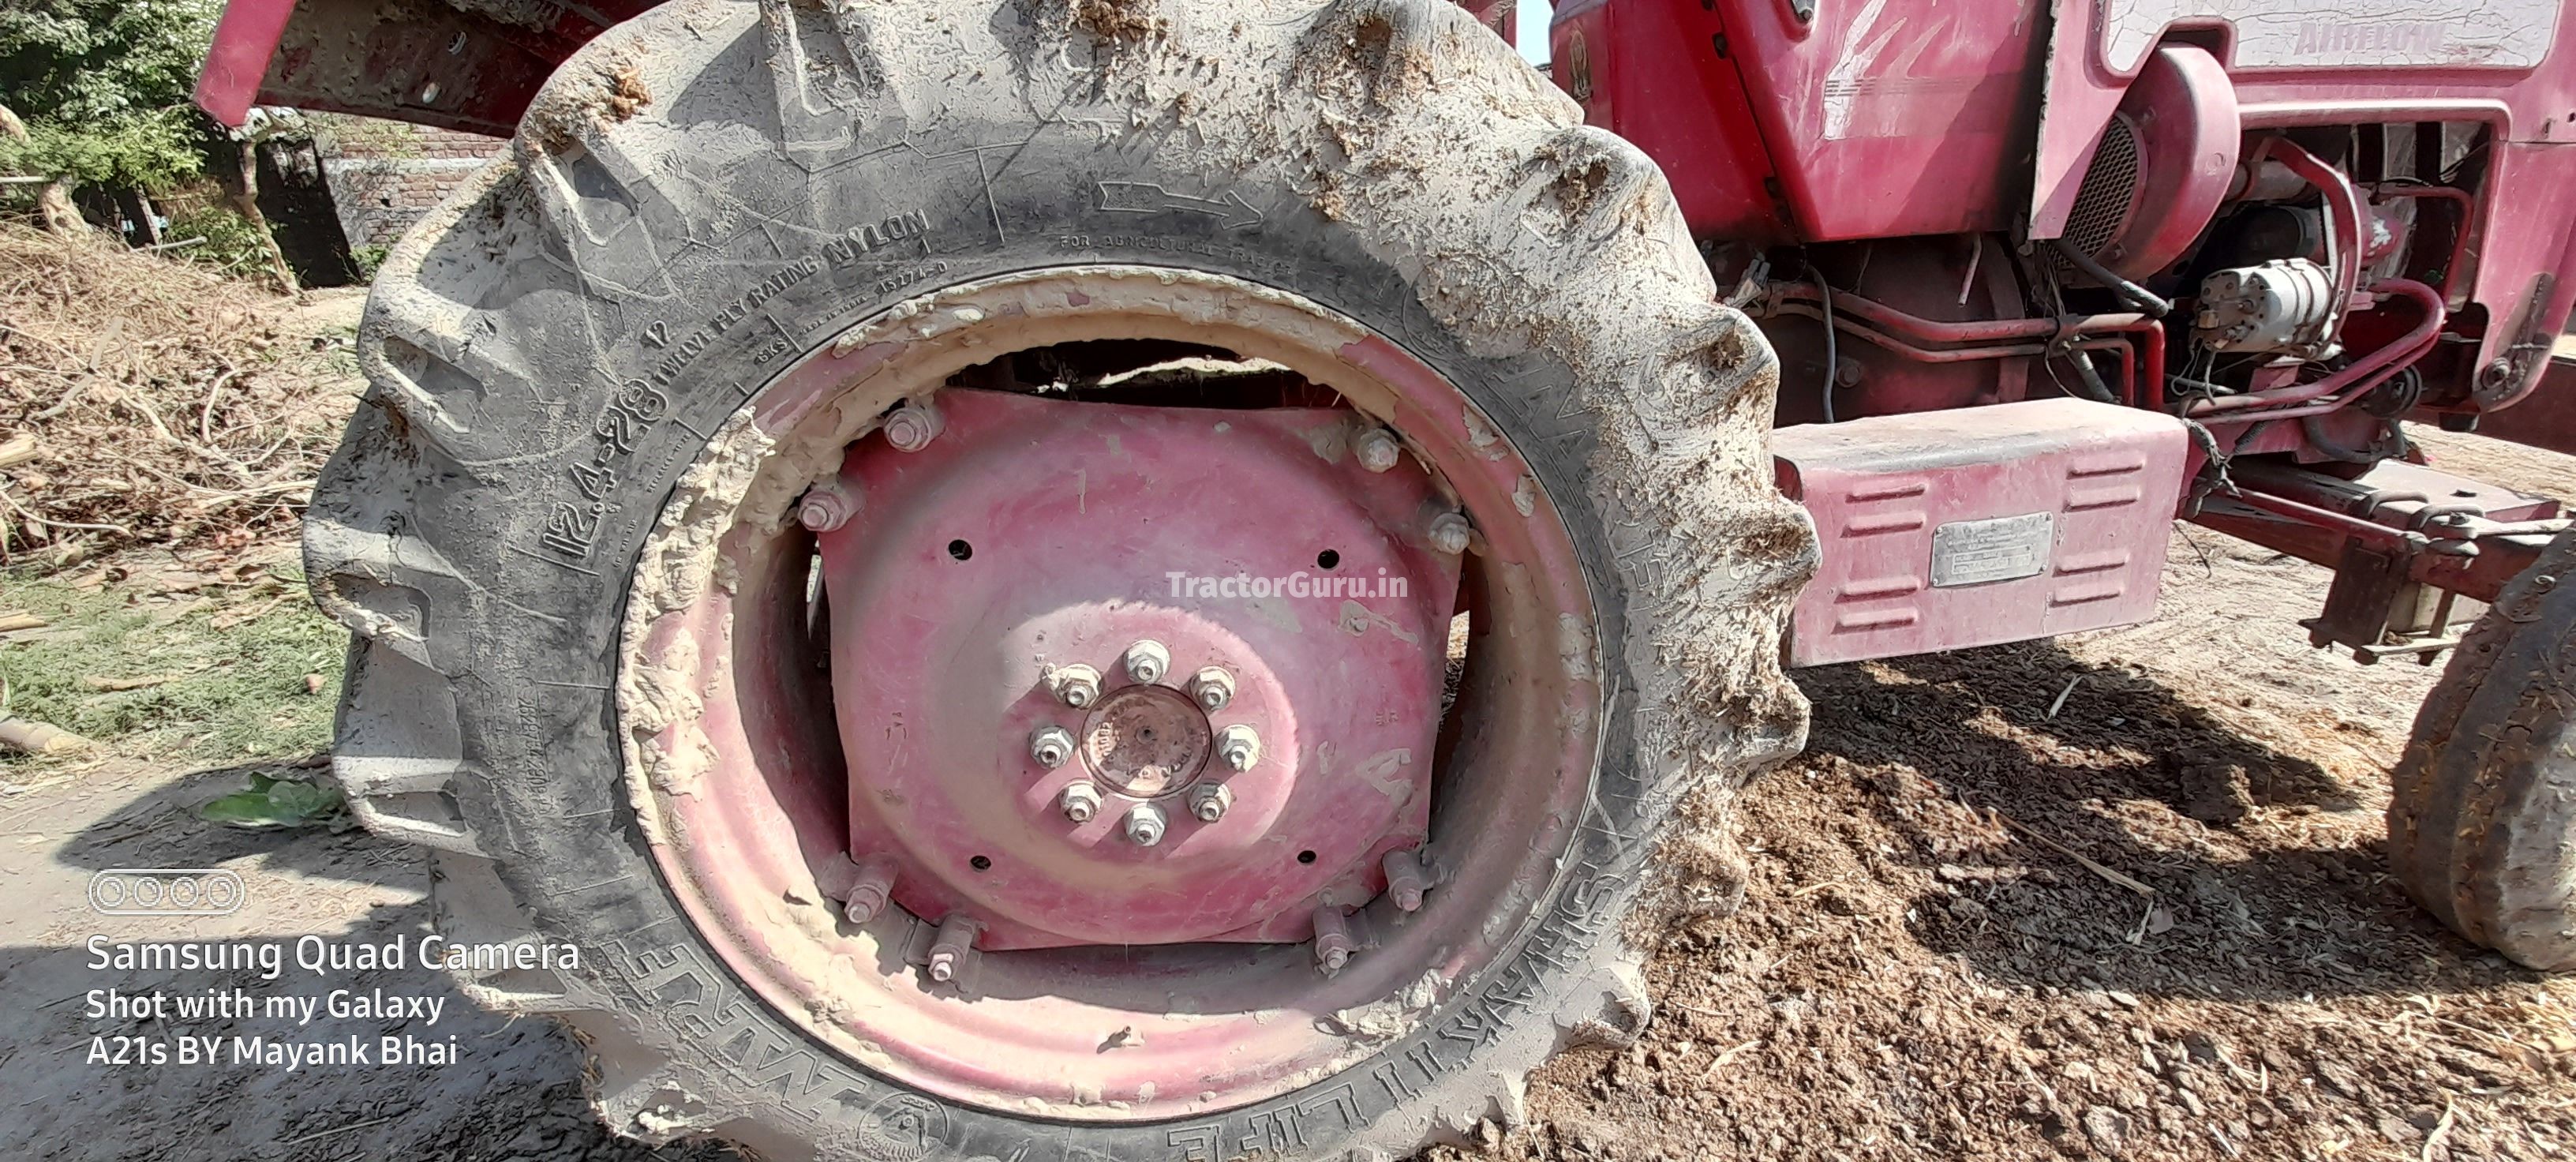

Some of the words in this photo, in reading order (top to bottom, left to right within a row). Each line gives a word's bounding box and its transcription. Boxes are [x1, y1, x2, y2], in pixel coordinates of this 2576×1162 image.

[2293, 22, 2447, 56] AIRFLOW
[1060, 235, 1091, 248] FOR
[644, 320, 671, 348] 12
[653, 329, 714, 385] TWELVE
[713, 297, 750, 335] PLY
[750, 255, 820, 309] RATING
[826, 208, 931, 264] NYLON
[541, 378, 670, 559] 12.4-28
[598, 938, 867, 1123] MRF
[1167, 1082, 1371, 1162] LIFE
